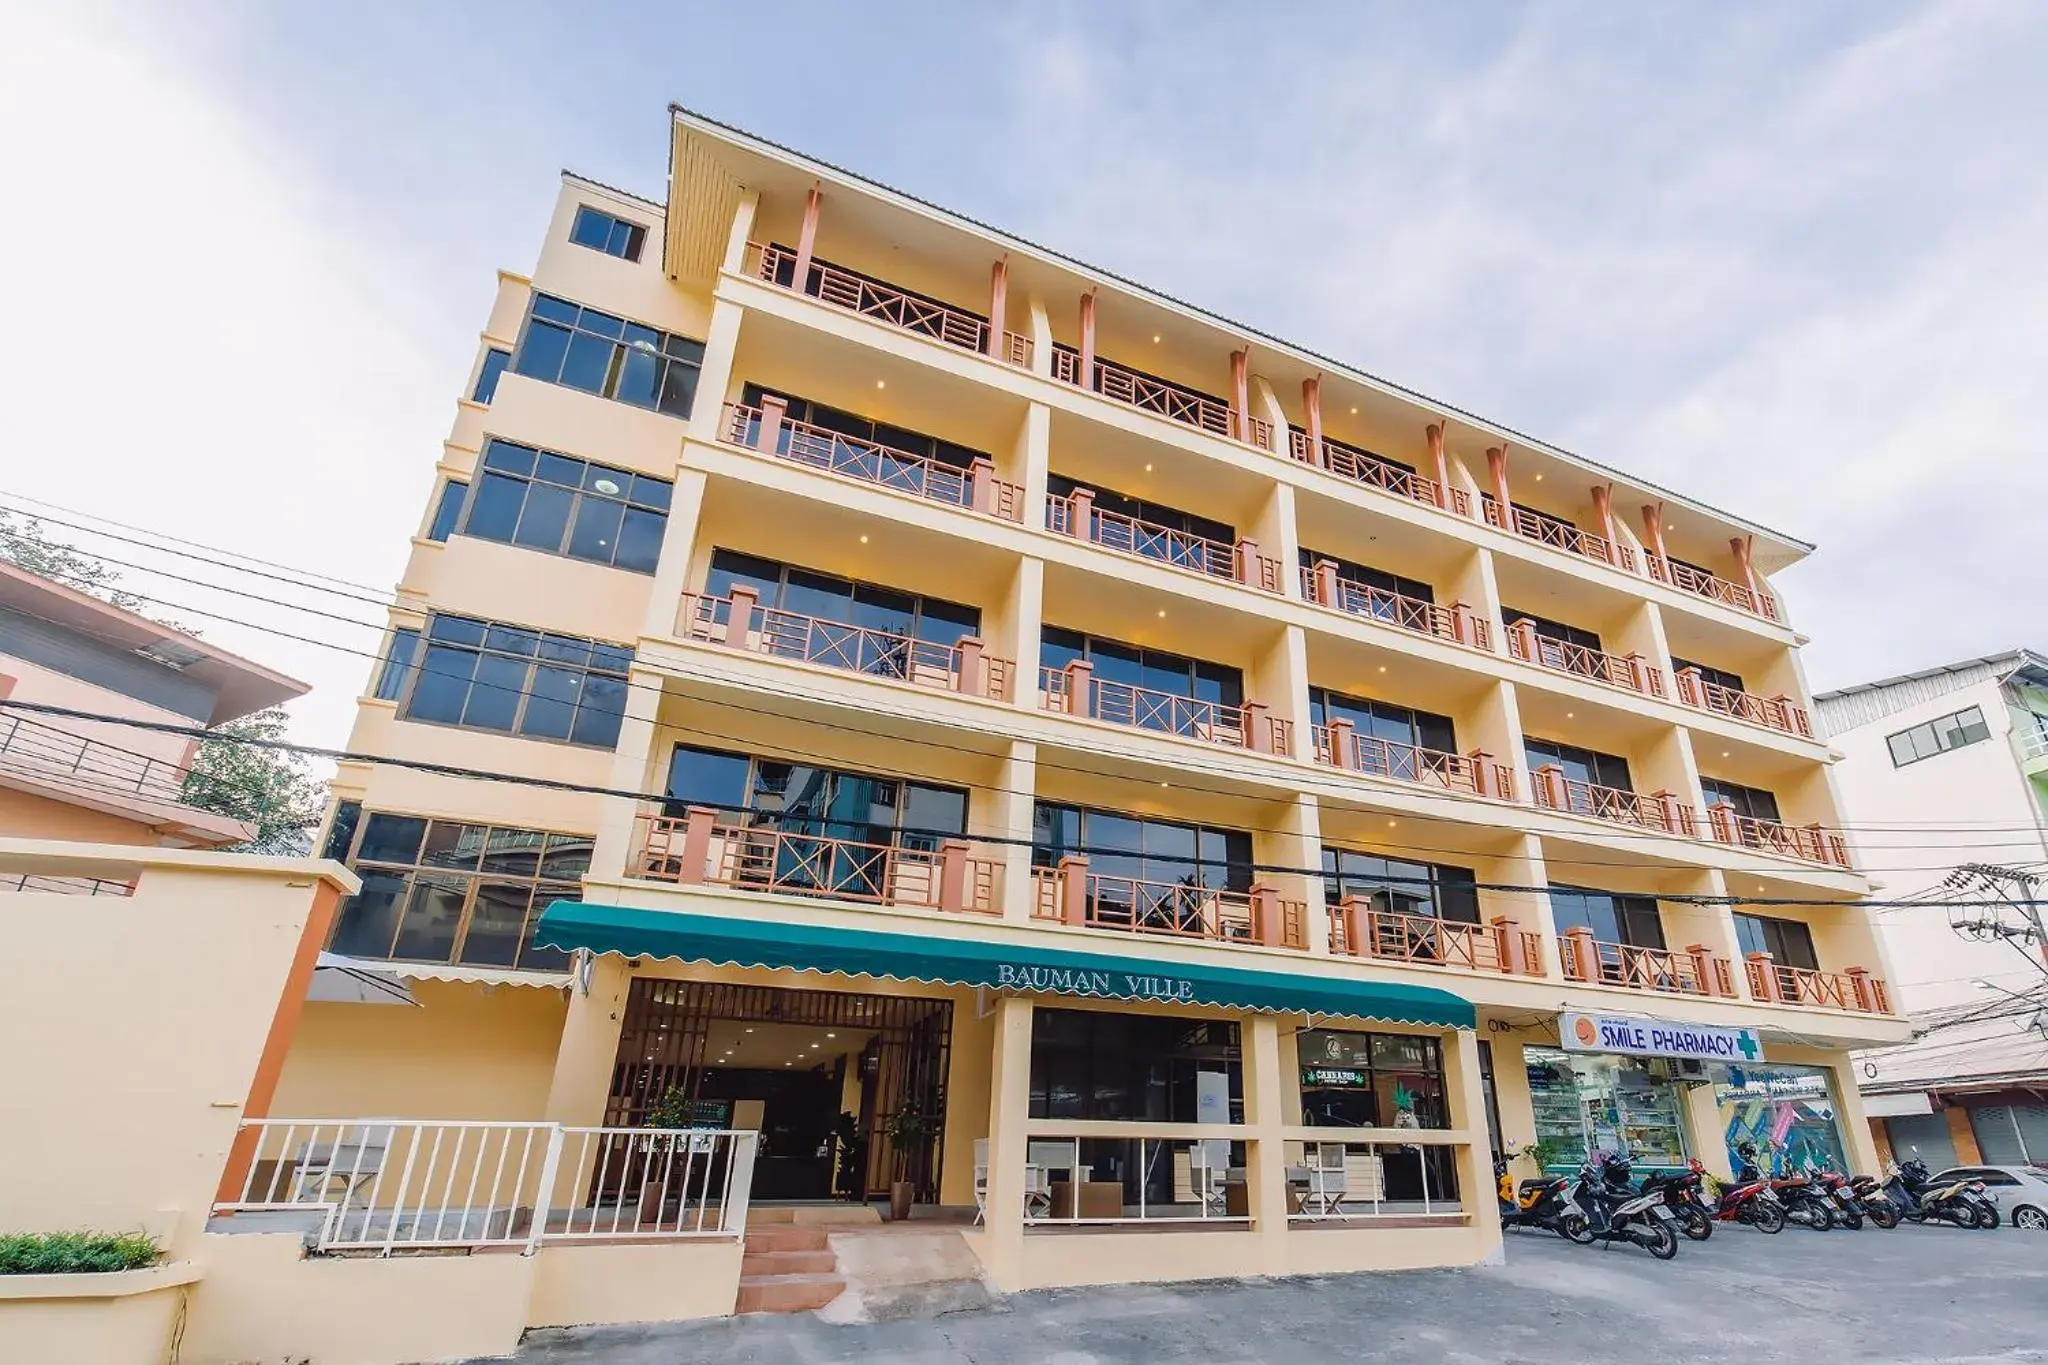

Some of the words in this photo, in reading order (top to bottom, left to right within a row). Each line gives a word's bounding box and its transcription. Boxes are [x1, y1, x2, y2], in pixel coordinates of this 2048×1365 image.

[998, 964, 1110, 991] BAUMAN
[1125, 975, 1194, 999] VILLE
[1601, 1025, 1646, 1049] SMILE
[1652, 1030, 1734, 1056] PHARMACY
